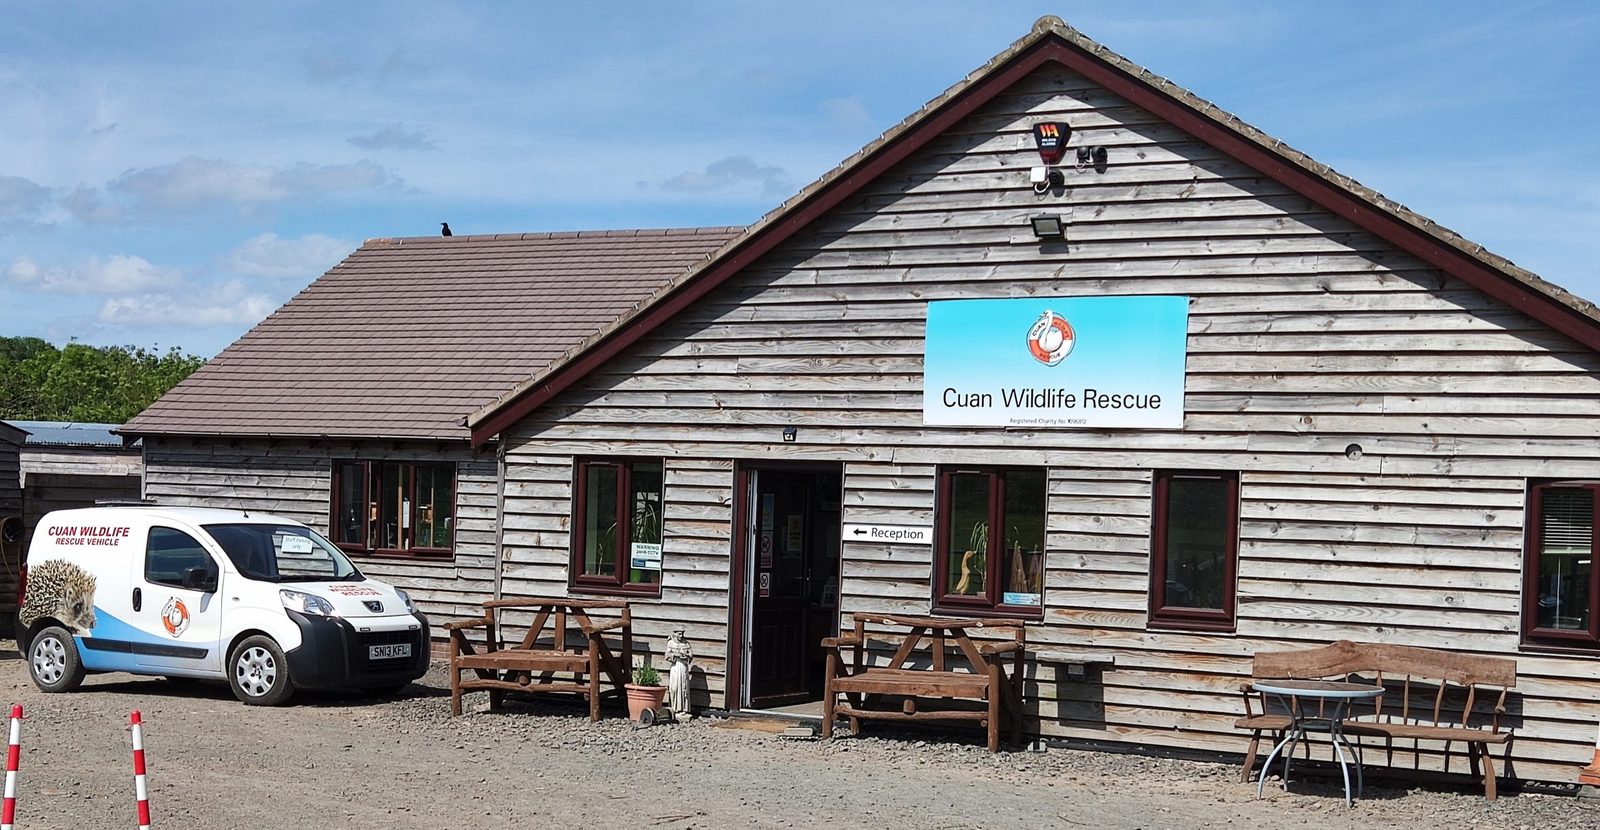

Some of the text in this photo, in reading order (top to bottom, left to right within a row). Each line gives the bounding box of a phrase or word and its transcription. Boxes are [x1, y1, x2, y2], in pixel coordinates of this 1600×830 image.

[1032, 322, 1046, 337] CUAN
[1039, 352, 1062, 360] RESCUE
[943, 387, 1161, 409] Cuan Wildlife Rescue
[1009, 417, 1037, 425] Registered
[48, 526, 130, 537] CUAN WILDLIFE
[871, 527, 924, 541] Reception
[55, 537, 119, 546] RESCUE VEHICLE
[374, 644, 407, 657] SN13 KFL
